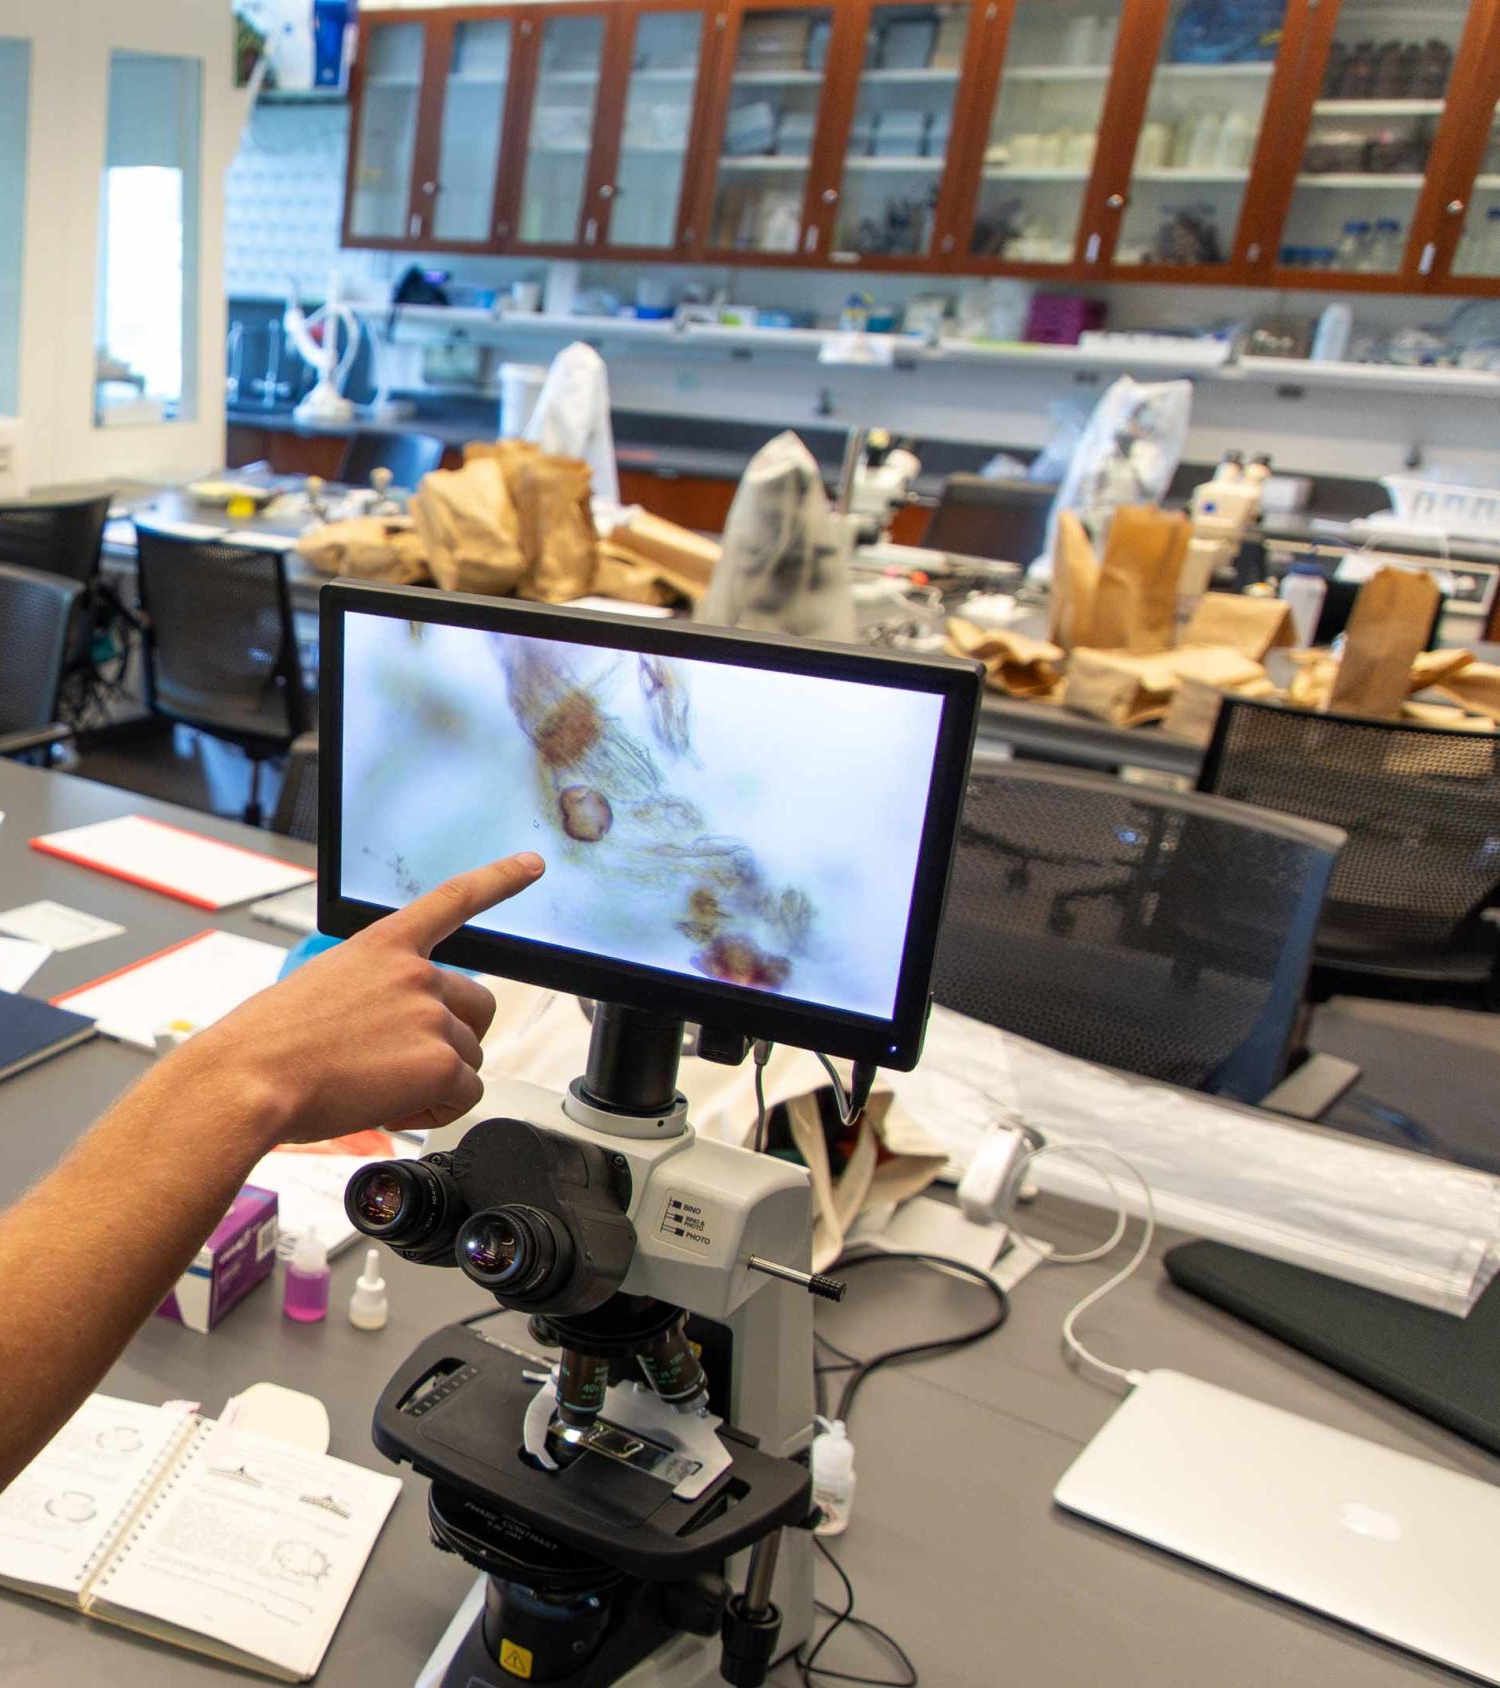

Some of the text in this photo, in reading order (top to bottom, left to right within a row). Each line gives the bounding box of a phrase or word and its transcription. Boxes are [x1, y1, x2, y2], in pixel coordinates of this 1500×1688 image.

[684, 1204, 701, 1214] BINO
[686, 1231, 710, 1244] PHOTO
[502, 1520, 558, 1550] CONTRAST
